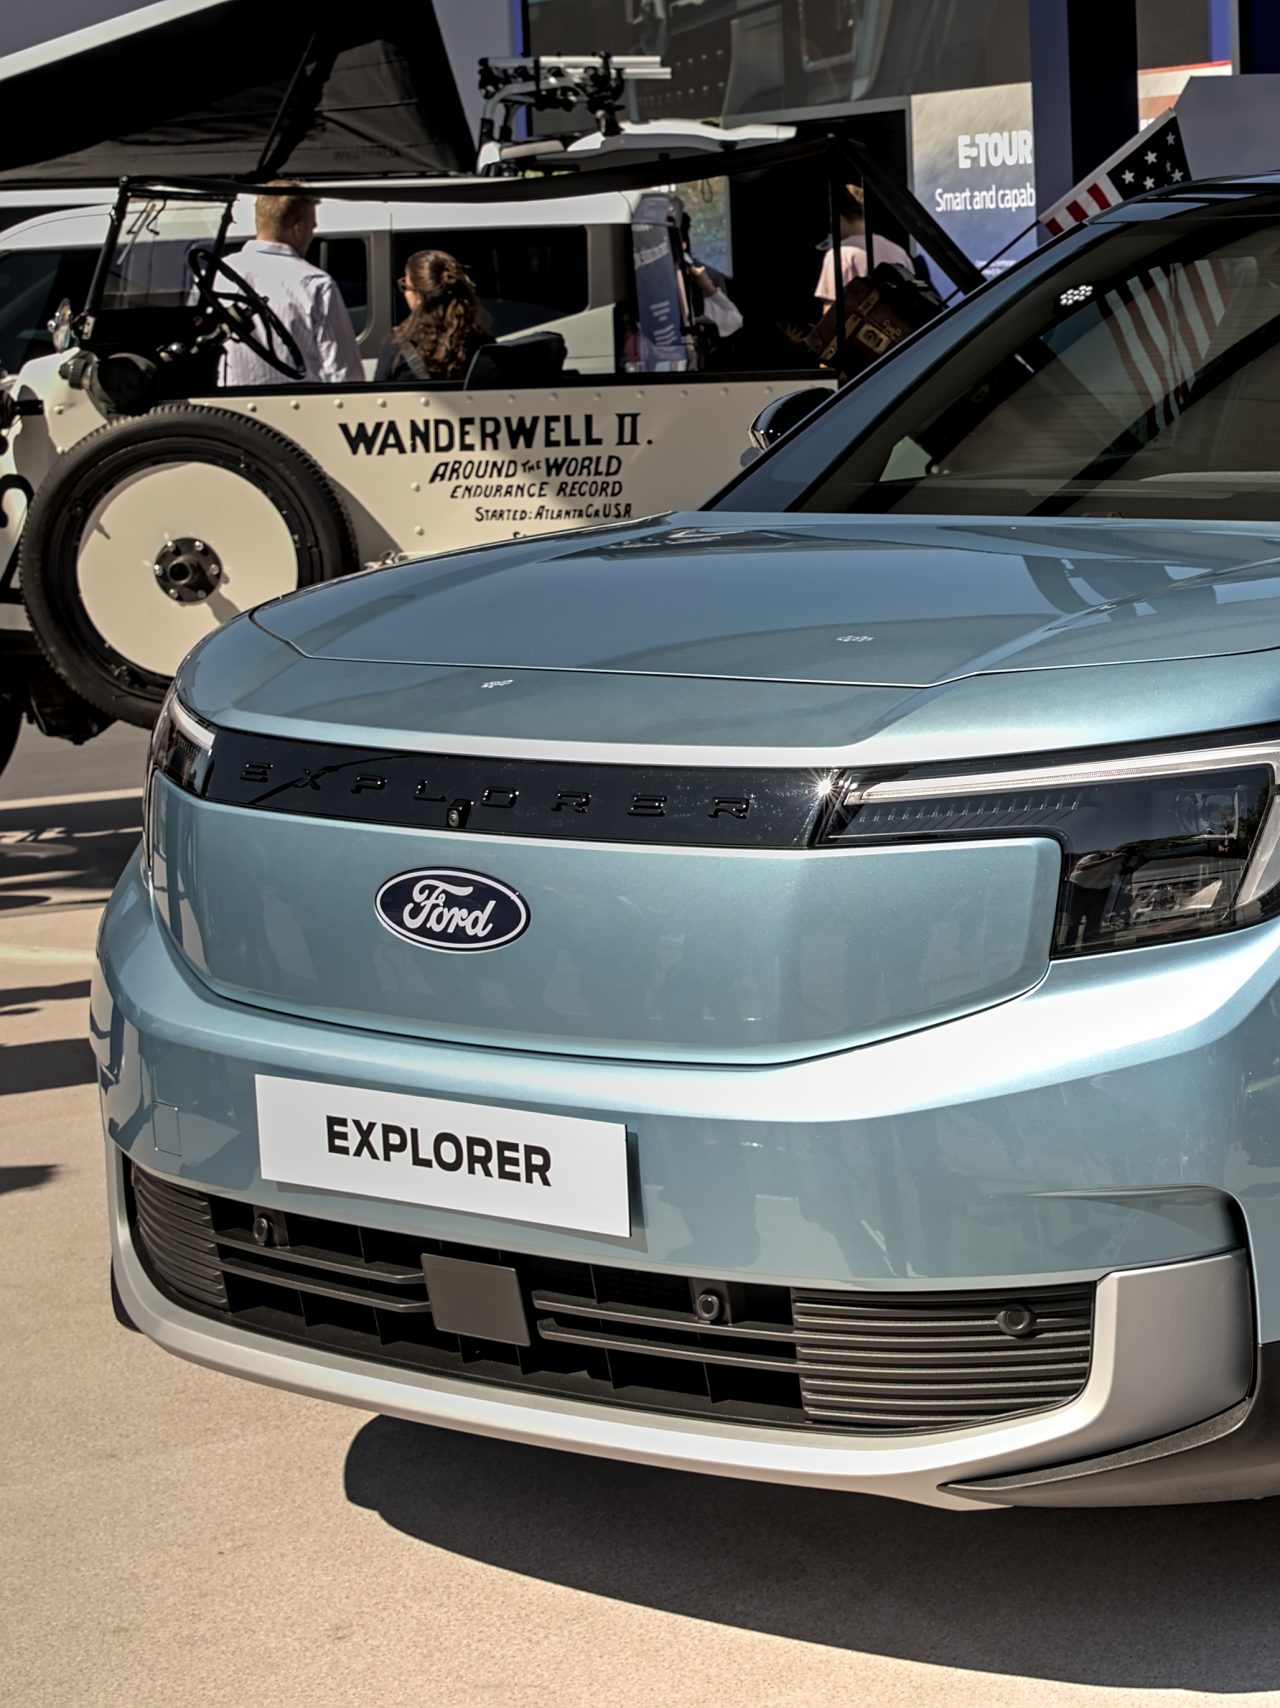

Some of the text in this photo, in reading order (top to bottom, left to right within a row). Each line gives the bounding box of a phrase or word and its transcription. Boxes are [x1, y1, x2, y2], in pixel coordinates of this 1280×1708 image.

[957, 130, 1033, 169] E-TOUR
[935, 183, 1036, 213] Smart and capab
[338, 414, 603, 456] WANDERWELL
[429, 460, 518, 484] AROUND
[545, 455, 622, 478] WORLD
[450, 480, 623, 499] ENDURANCE RECORD
[239, 762, 750, 820] EXPLORER
[403, 879, 497, 937] Ford
[326, 1114, 552, 1187] EXPLORER
